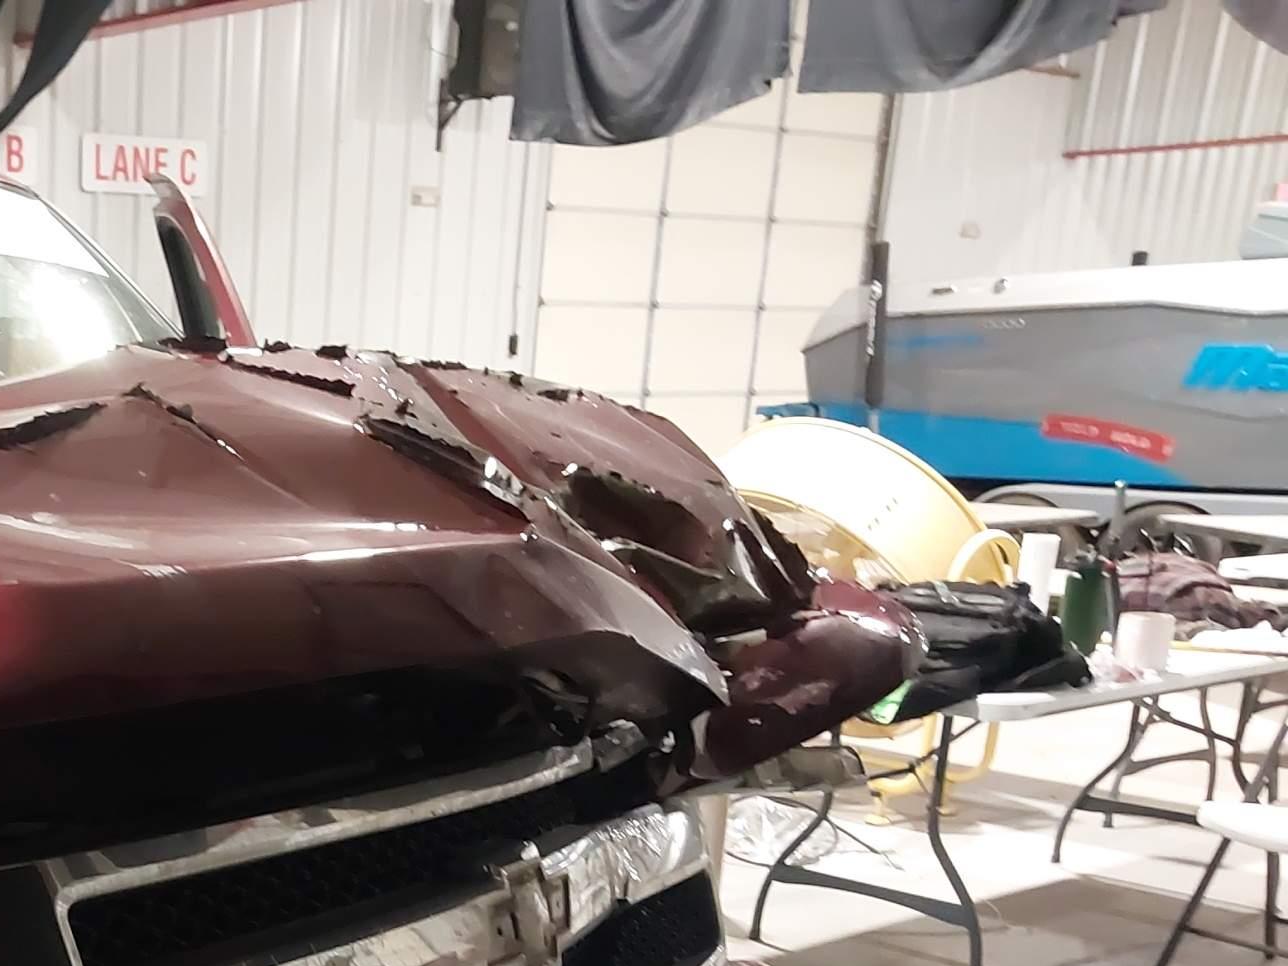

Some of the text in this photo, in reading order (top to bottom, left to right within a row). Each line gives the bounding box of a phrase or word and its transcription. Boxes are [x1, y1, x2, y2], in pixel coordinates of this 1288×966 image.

[7, 134, 24, 173] B
[95, 143, 197, 186] LANE C
